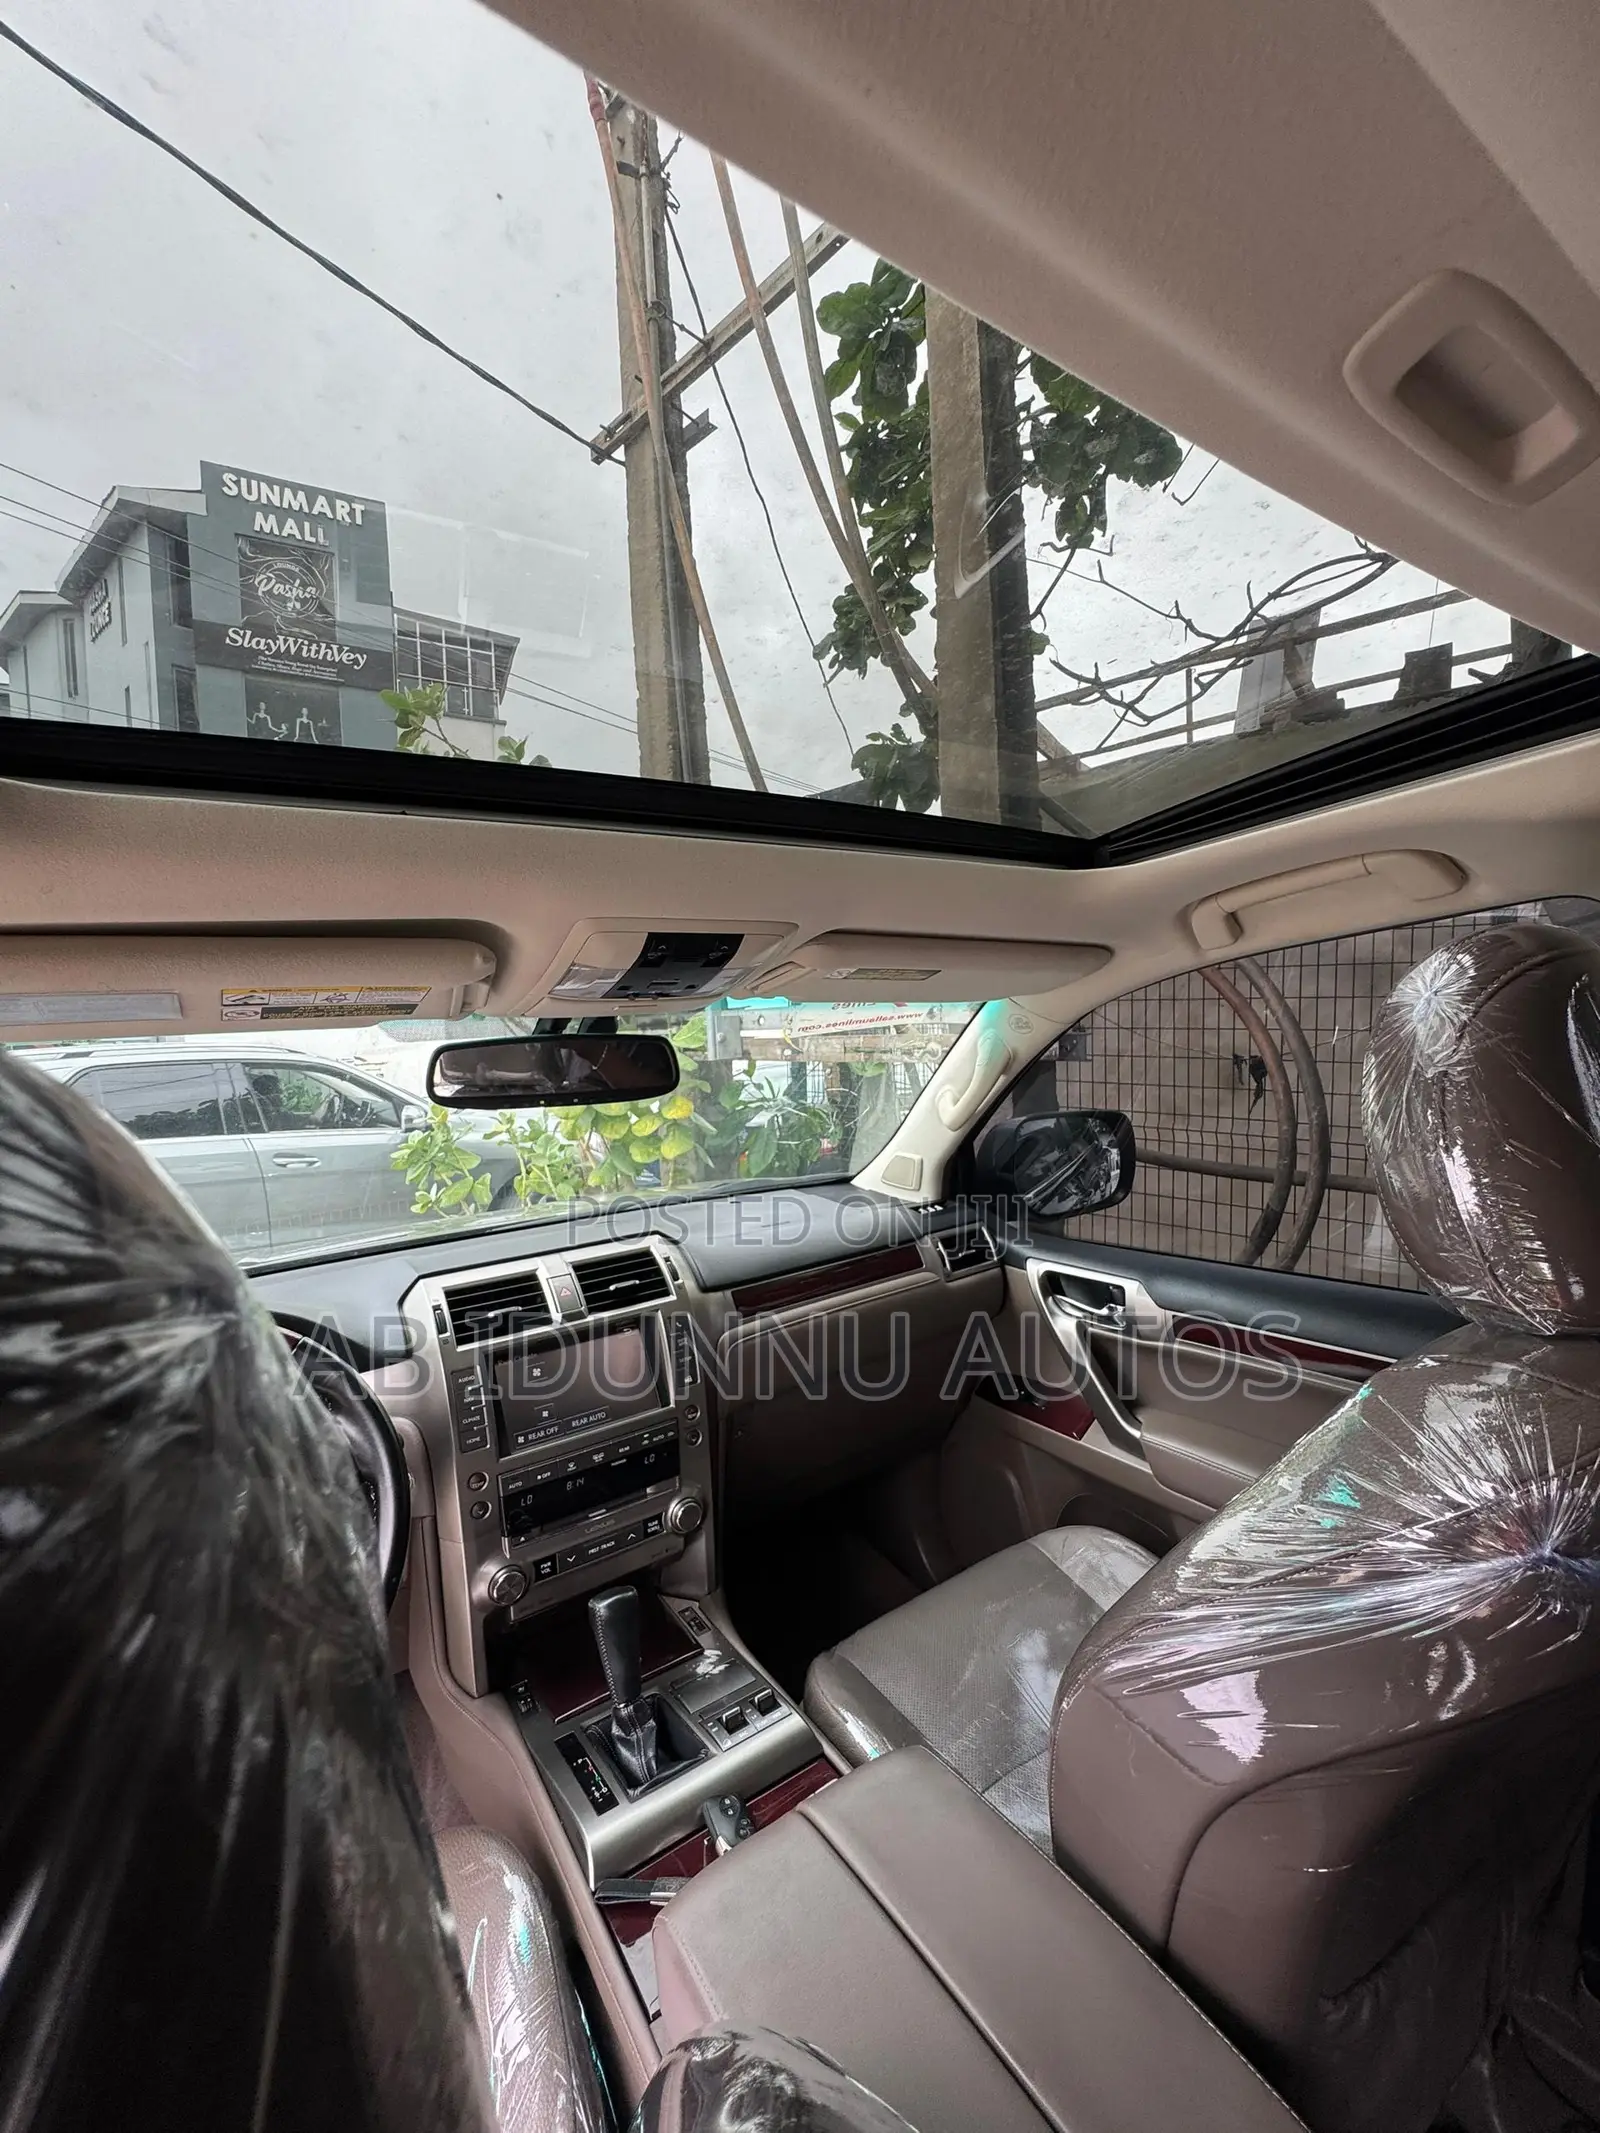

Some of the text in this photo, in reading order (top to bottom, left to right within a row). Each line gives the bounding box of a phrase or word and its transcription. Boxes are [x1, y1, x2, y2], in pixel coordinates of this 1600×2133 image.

[221, 472, 366, 526] SUNMART
[253, 511, 329, 546] MALL
[225, 627, 367, 670] SlayWithVey
[572, 1411, 606, 1428] REAR AUTO
[528, 1425, 559, 1441] REAR OFF
[508, 1481, 523, 1490] AUTO
